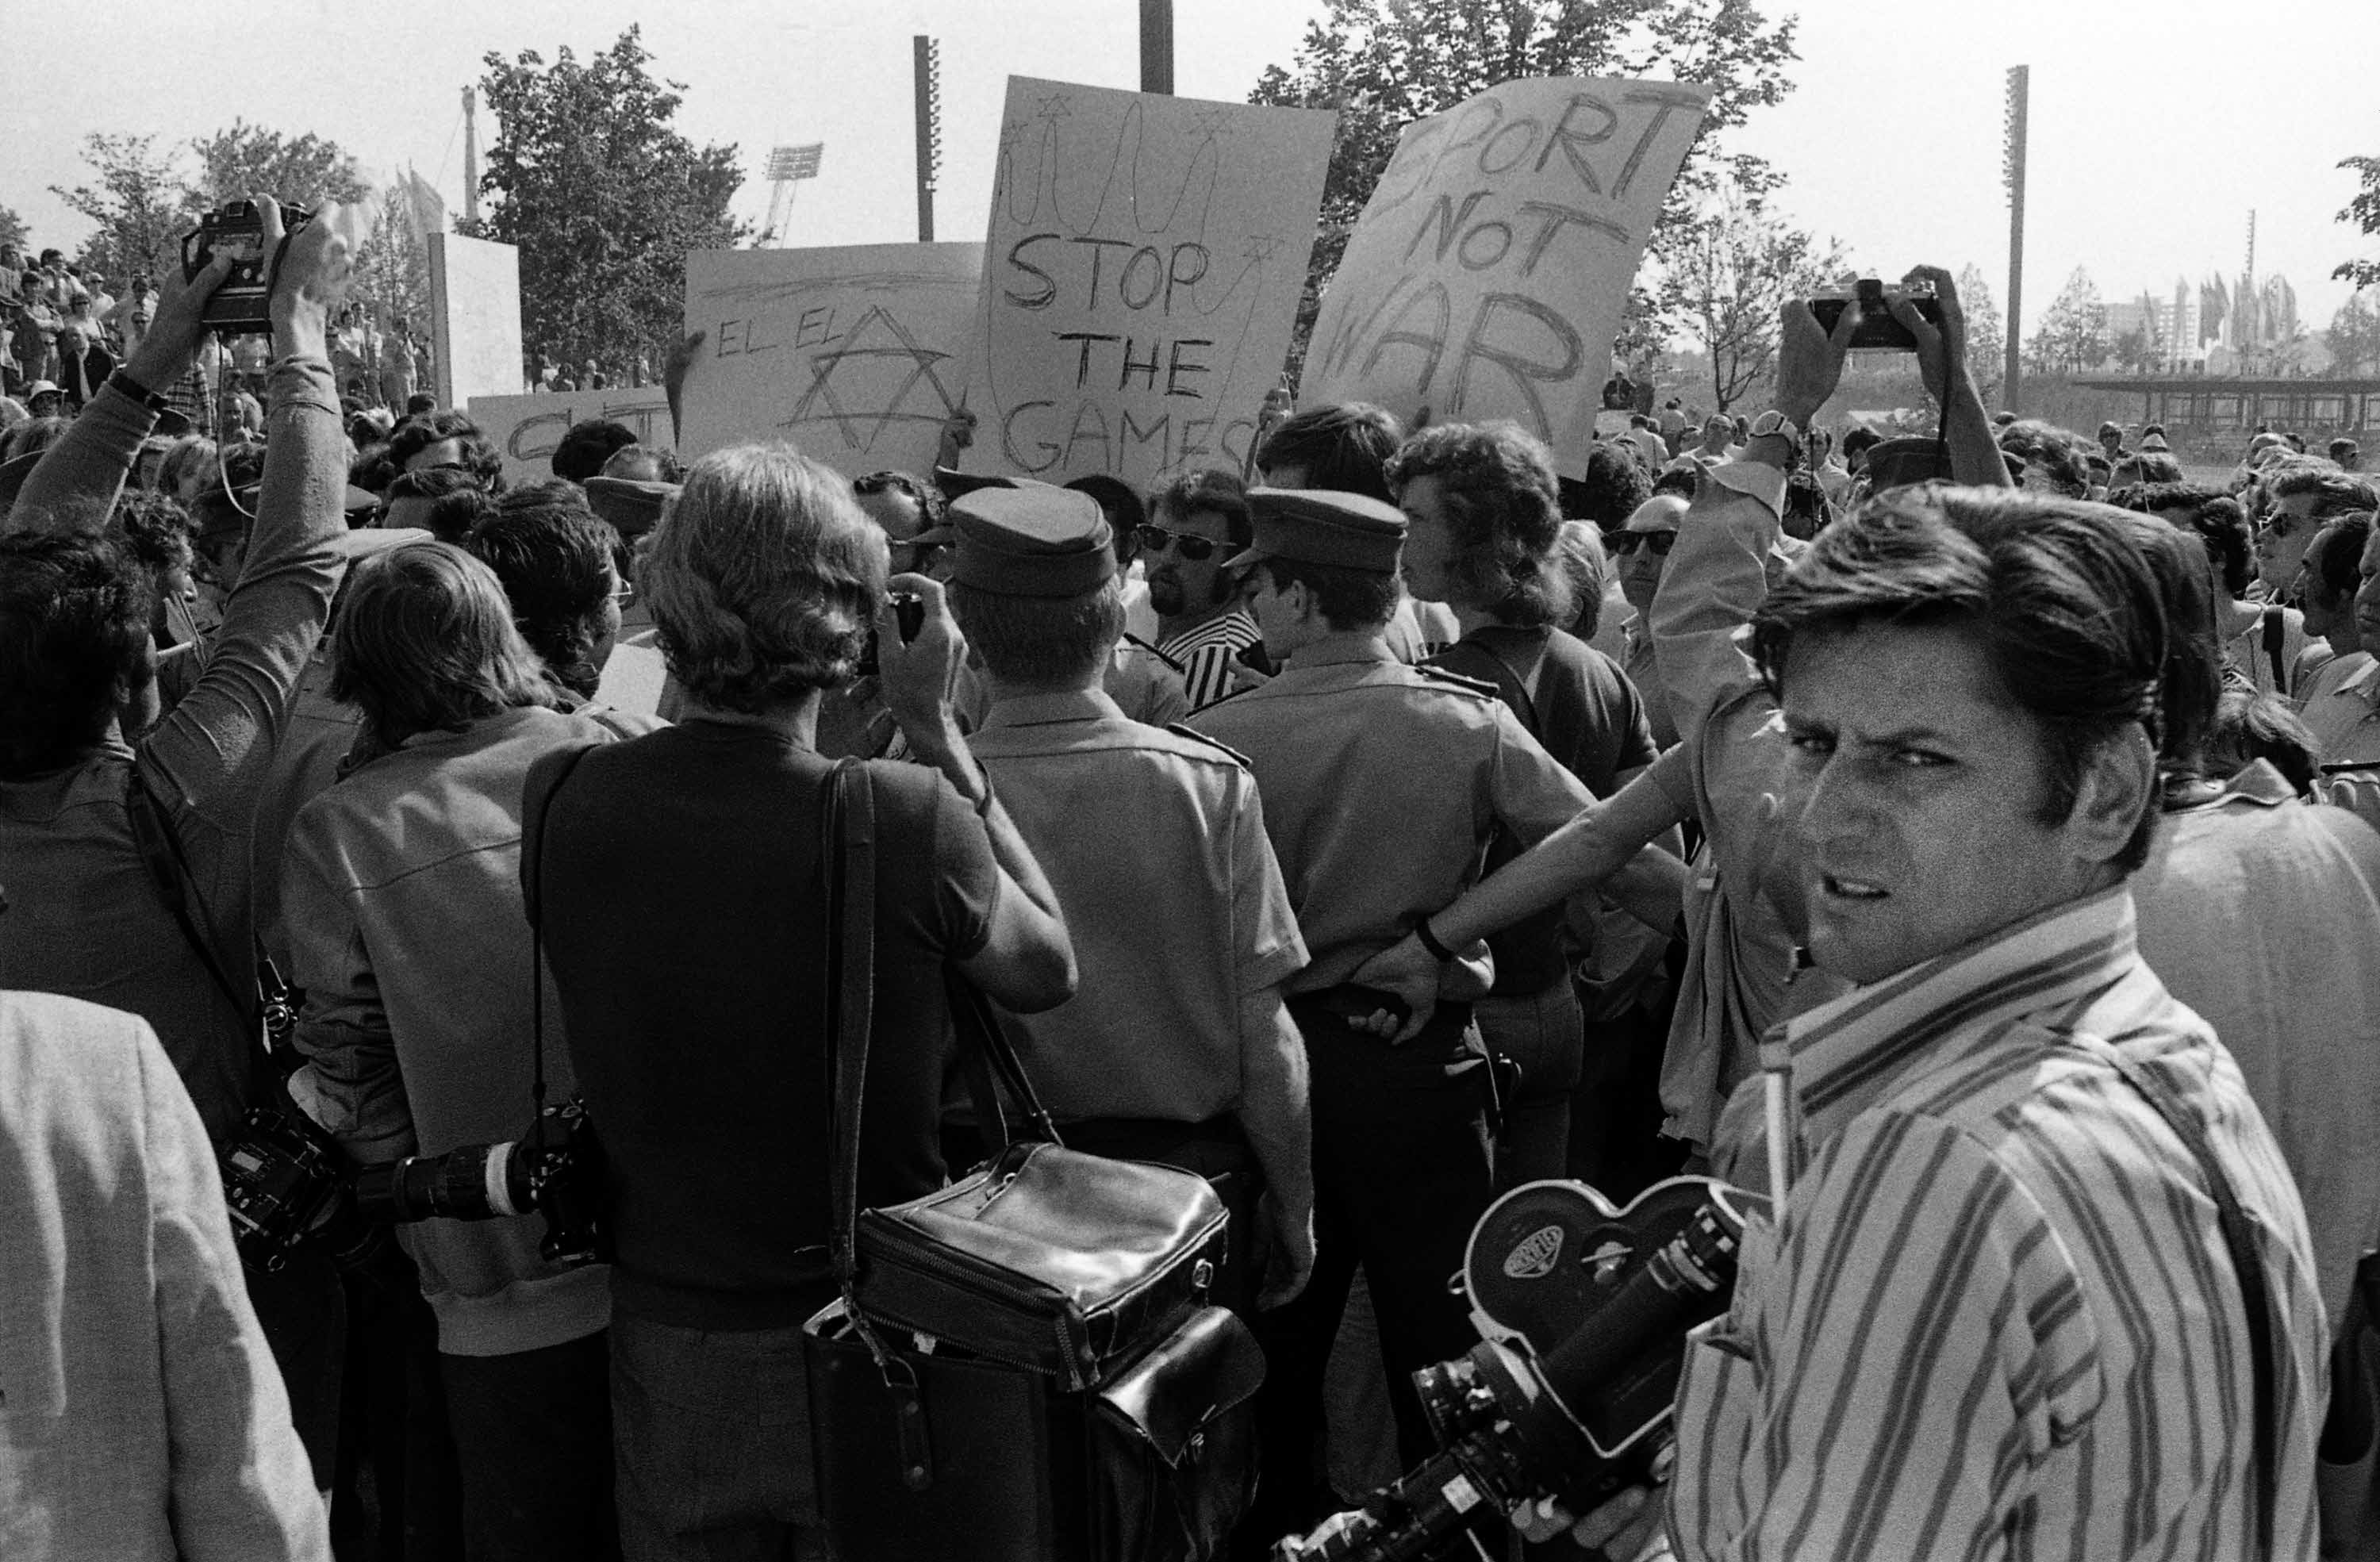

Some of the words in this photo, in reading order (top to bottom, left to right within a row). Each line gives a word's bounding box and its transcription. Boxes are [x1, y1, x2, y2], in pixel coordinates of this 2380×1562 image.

[1004, 232, 1211, 317] STOP
[1403, 189, 1630, 278] NOT
[717, 317, 778, 358] EL
[795, 305, 844, 349] EL
[1052, 331, 1214, 399] THE
[1319, 272, 1583, 446] WAR
